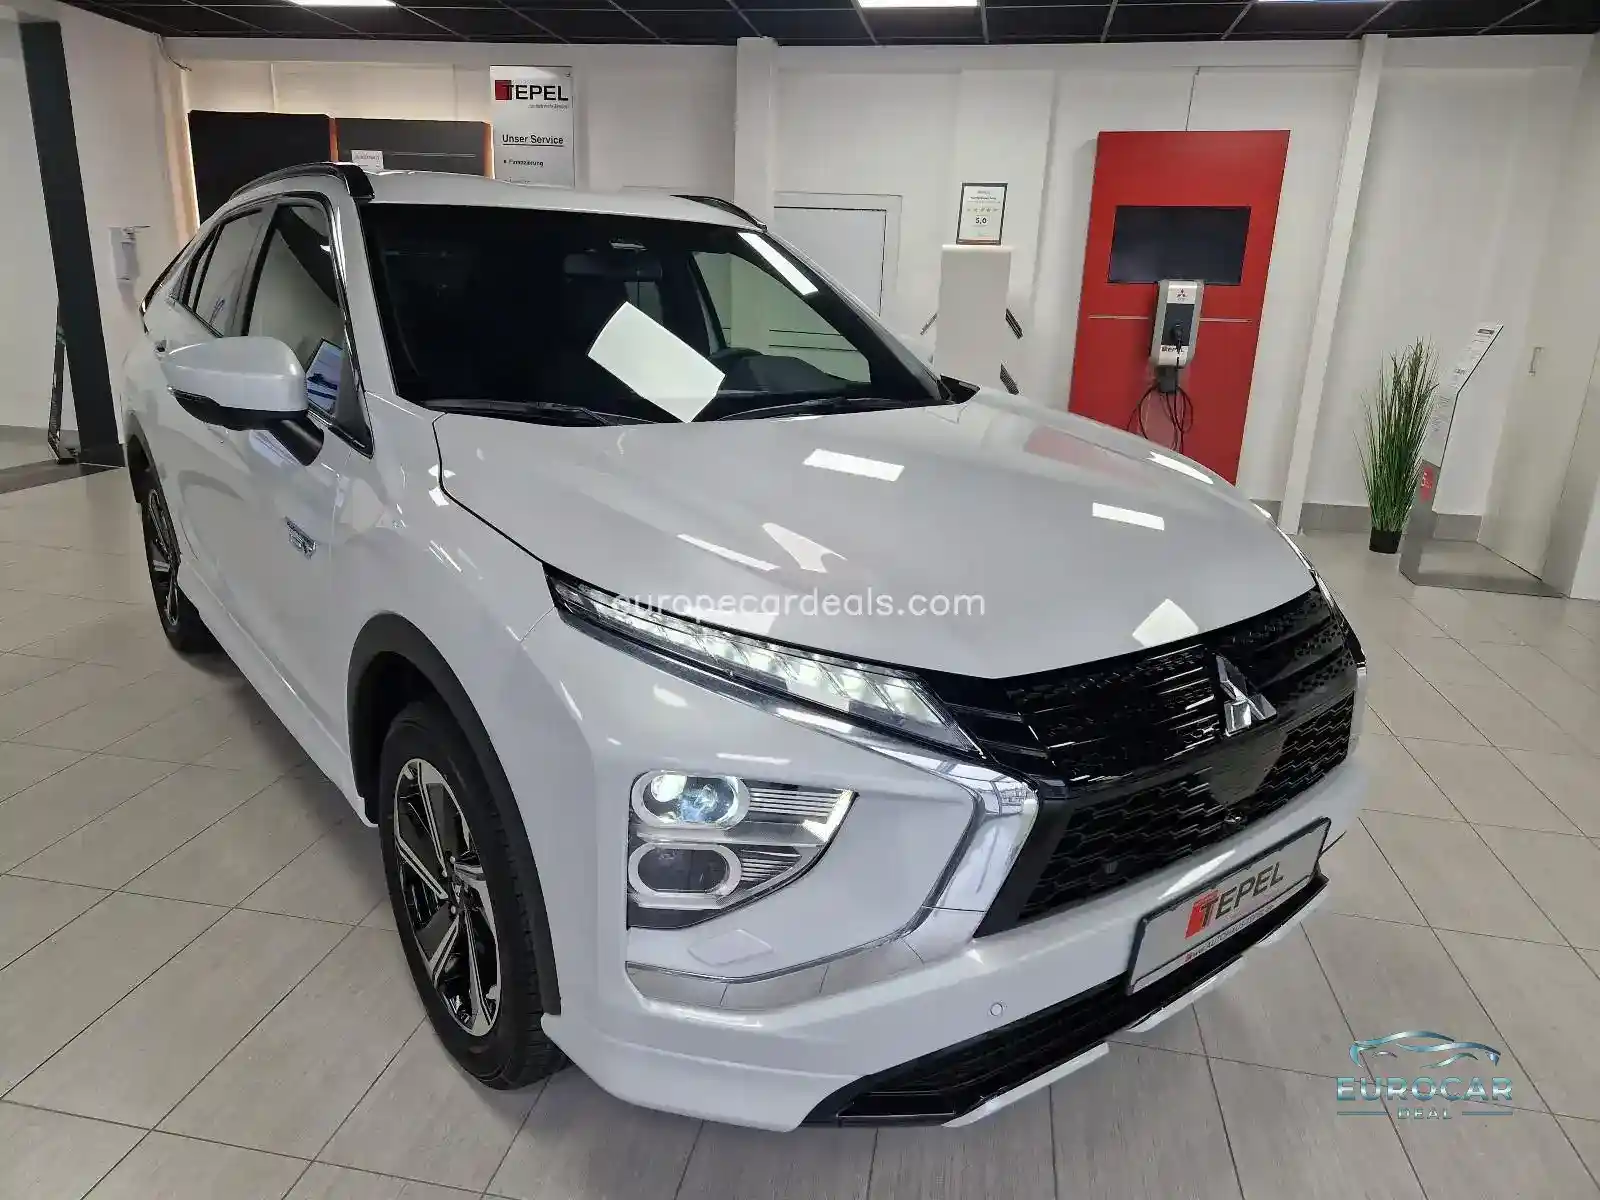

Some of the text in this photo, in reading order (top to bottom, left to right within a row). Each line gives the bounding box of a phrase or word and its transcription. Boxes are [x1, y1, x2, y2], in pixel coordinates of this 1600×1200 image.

[499, 84, 569, 101] TEPEL
[502, 134, 564, 145] Unser Service
[1191, 861, 1284, 931] TEPEL
